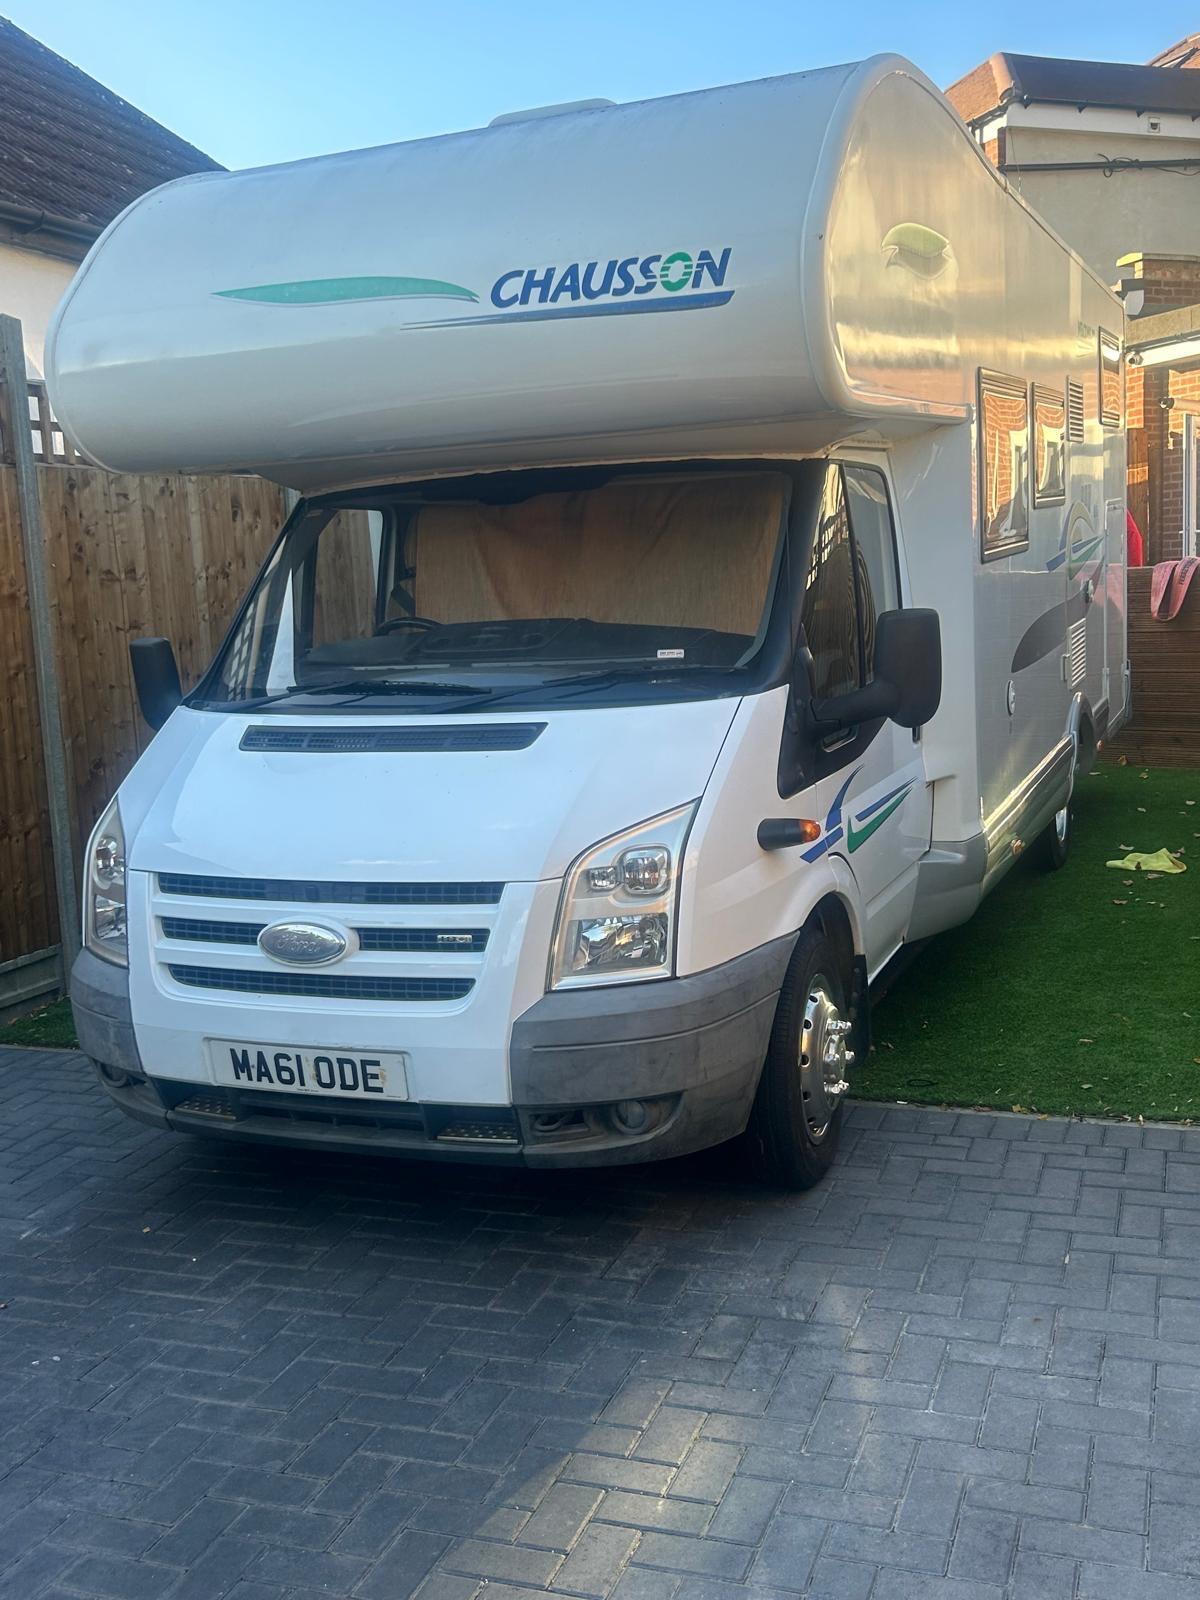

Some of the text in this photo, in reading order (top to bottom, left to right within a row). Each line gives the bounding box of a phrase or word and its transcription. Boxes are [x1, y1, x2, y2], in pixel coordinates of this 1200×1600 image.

[490, 247, 733, 309] CHAUSSON
[230, 1048, 384, 1093] MA61 ODE
